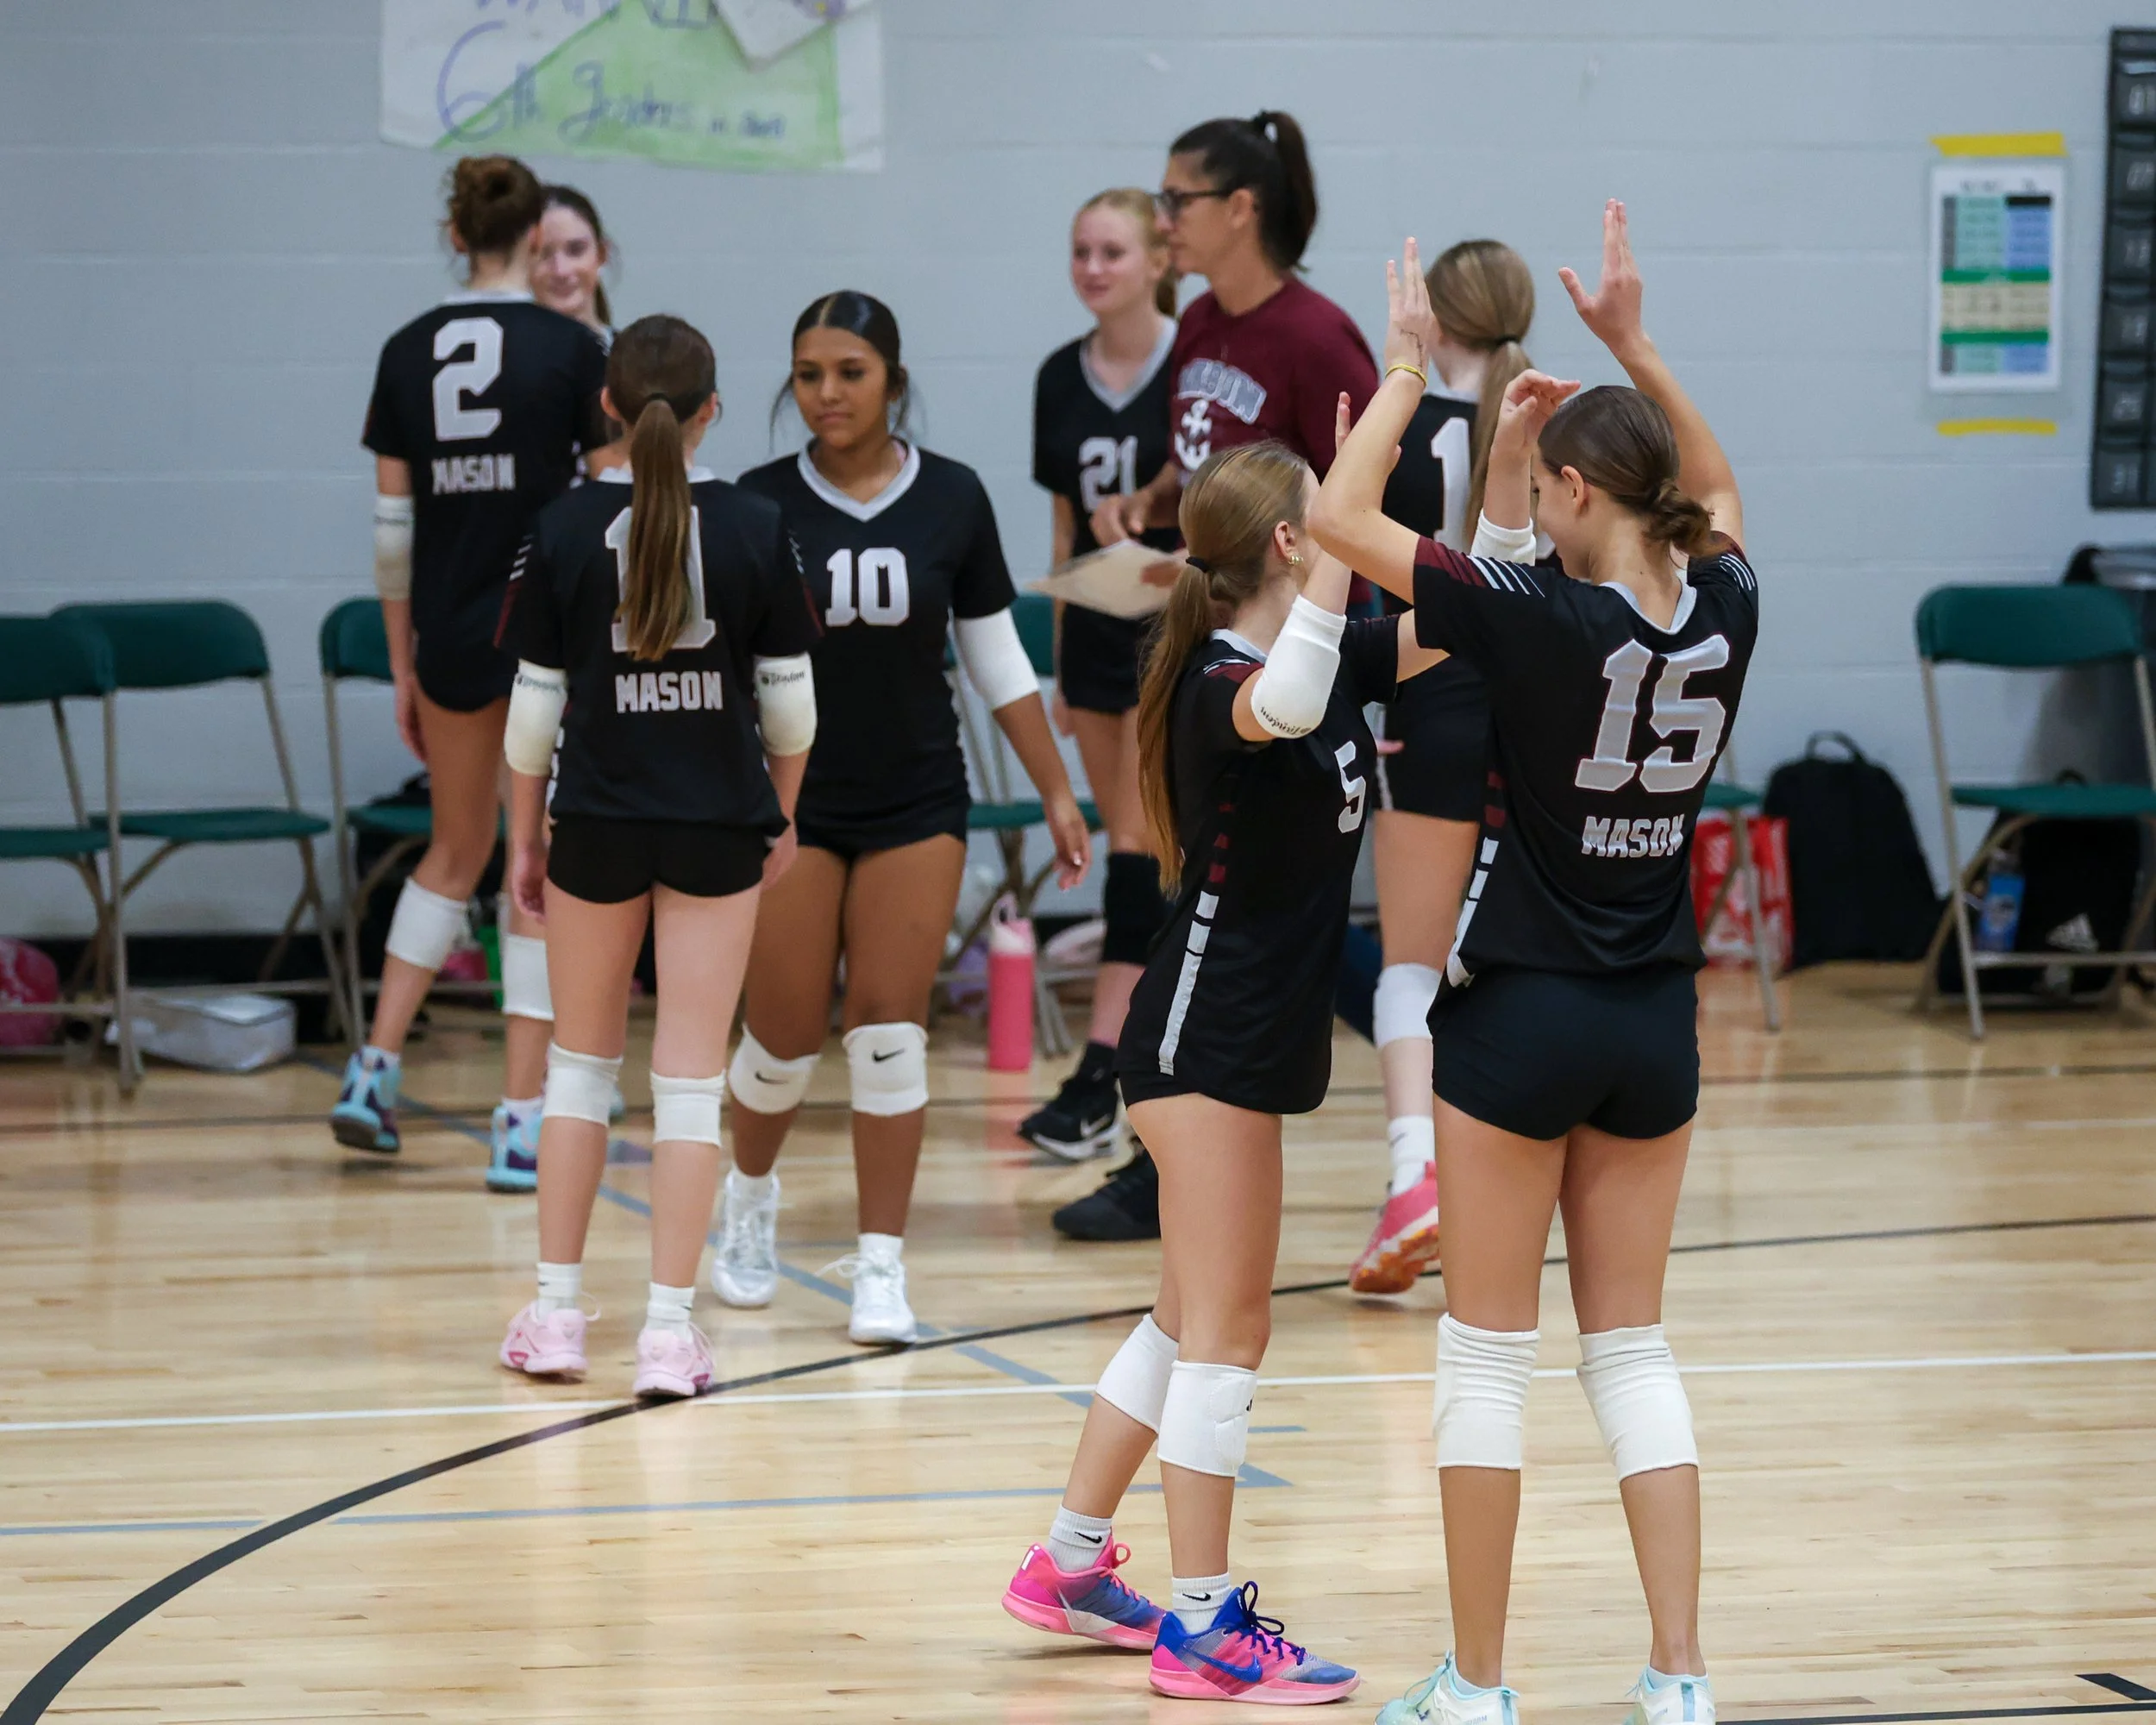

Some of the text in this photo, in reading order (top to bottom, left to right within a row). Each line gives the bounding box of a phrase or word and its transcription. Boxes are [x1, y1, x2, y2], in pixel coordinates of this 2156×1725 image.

[433, 316, 505, 442] 2
[431, 454, 517, 495] MASON
[1078, 435, 1138, 513] 21
[825, 547, 911, 627] 10
[615, 671, 724, 713] MASON
[1575, 634, 1730, 793] 15
[1334, 740, 1367, 833] 5
[1582, 814, 1685, 858] MASON
